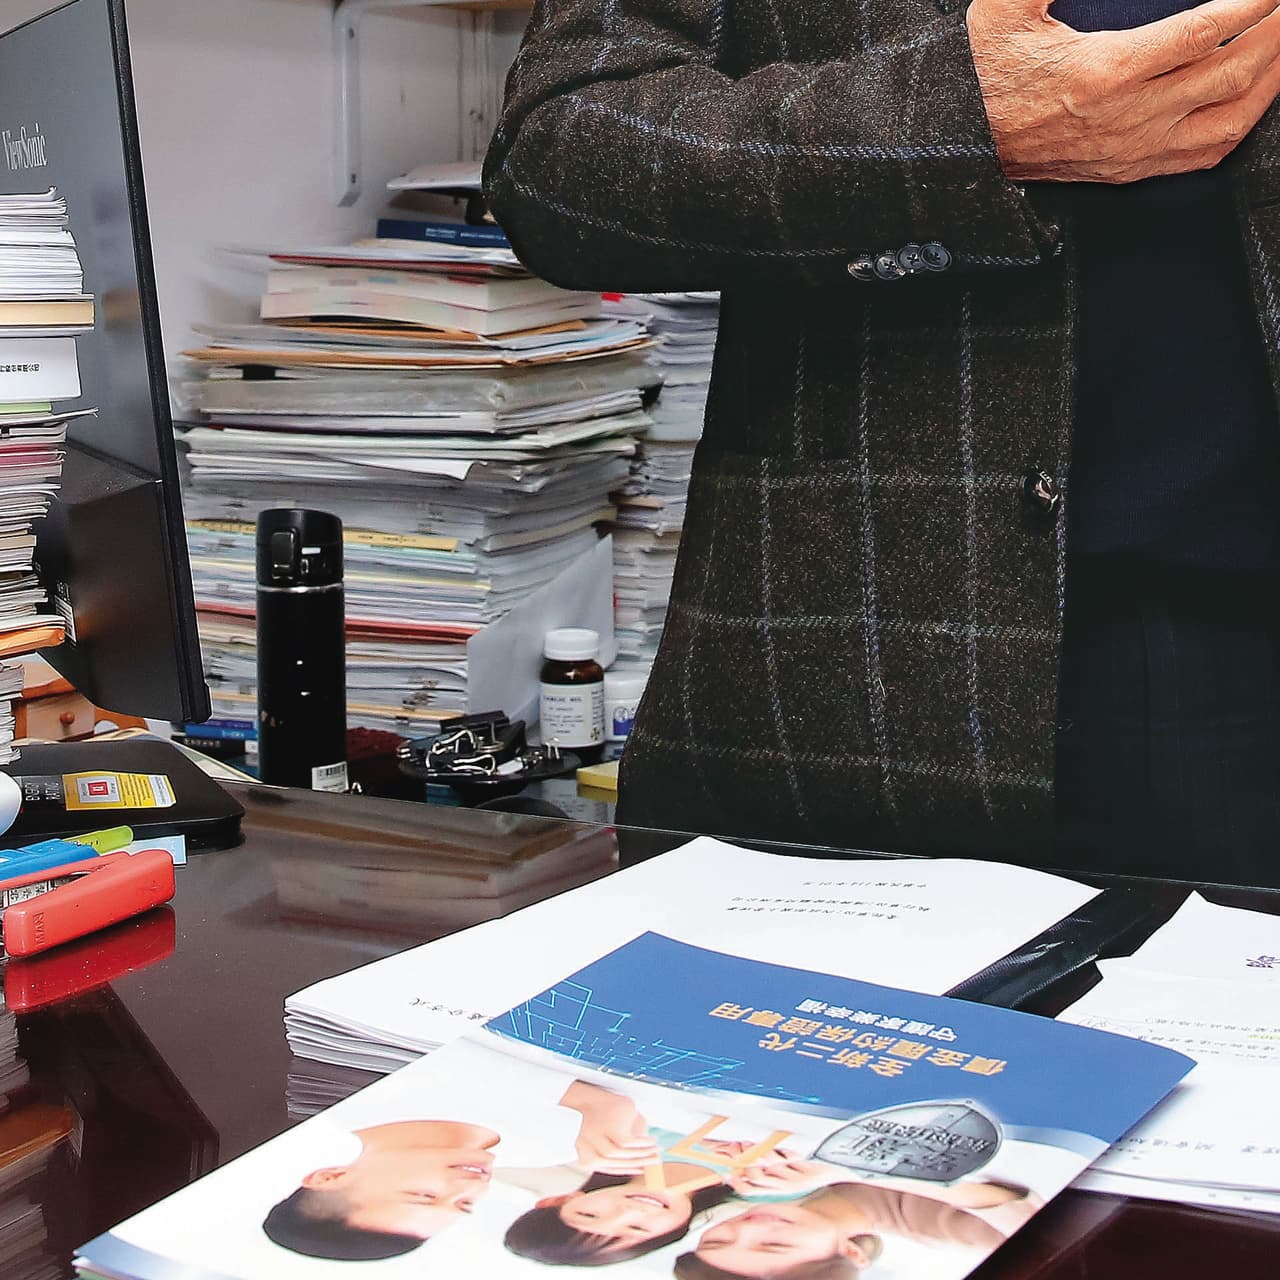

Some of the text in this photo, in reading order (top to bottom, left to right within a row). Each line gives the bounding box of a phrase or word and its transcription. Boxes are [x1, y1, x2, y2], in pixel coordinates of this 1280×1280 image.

[1, 122, 48, 171] ViewSonic
[708, 1002, 1008, 1076] 價金履約保證專用
[758, 1033, 913, 1078] 全新二代
